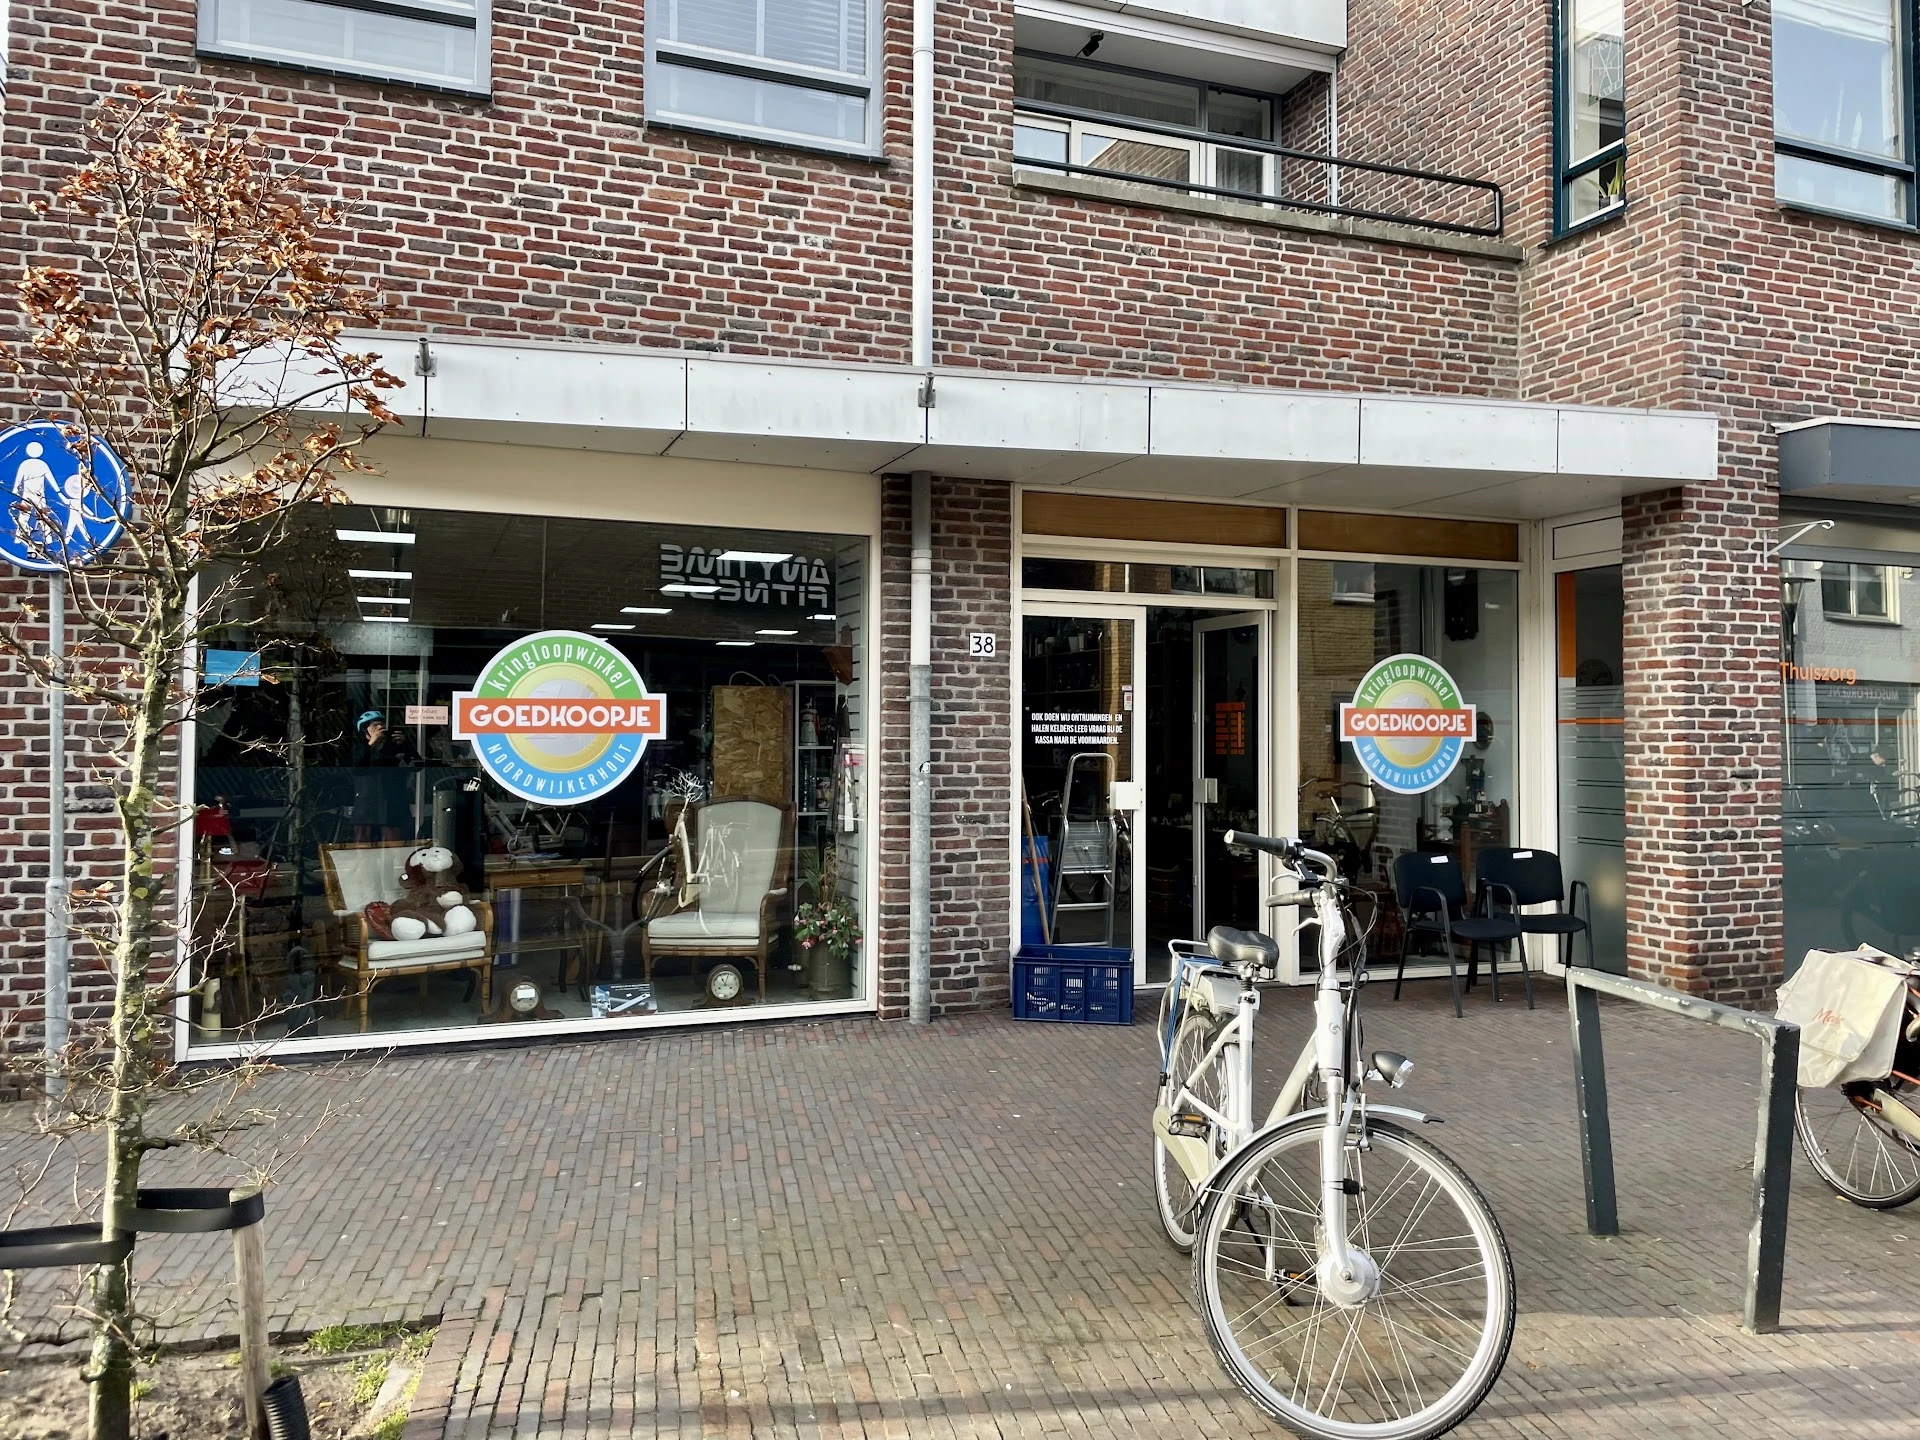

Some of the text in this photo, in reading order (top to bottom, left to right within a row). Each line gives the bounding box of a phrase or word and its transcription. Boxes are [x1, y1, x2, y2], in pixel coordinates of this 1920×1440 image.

[972, 635, 994, 654] 38
[486, 643, 632, 692] kringloopwinkel
[1779, 662, 1857, 686] Thuiszorg
[1361, 664, 1454, 703] kringloopwinkel
[469, 704, 651, 727] GOEDKOOPJE
[1031, 712, 1043, 721] OOK
[1044, 712, 1060, 722] DOEN
[1071, 713, 1113, 722] ONTRUIMINGEN
[1115, 713, 1123, 722] EN
[1350, 713, 1467, 731] GOEDKOOPJE
[1031, 723, 1050, 733] HALEN
[1050, 724, 1075, 733] KELDERS
[1075, 724, 1088, 733] LEEG
[1089, 724, 1107, 733] VRAAG
[1116, 725, 1123, 734] DE
[1035, 735, 1053, 745] KASSA
[1054, 735, 1069, 745] NAAR
[1070, 735, 1077, 745] DE
[487, 742, 632, 794] NOORDWIJKERHOUT
[1361, 743, 1455, 786] NOORDWIJKERHOUT
